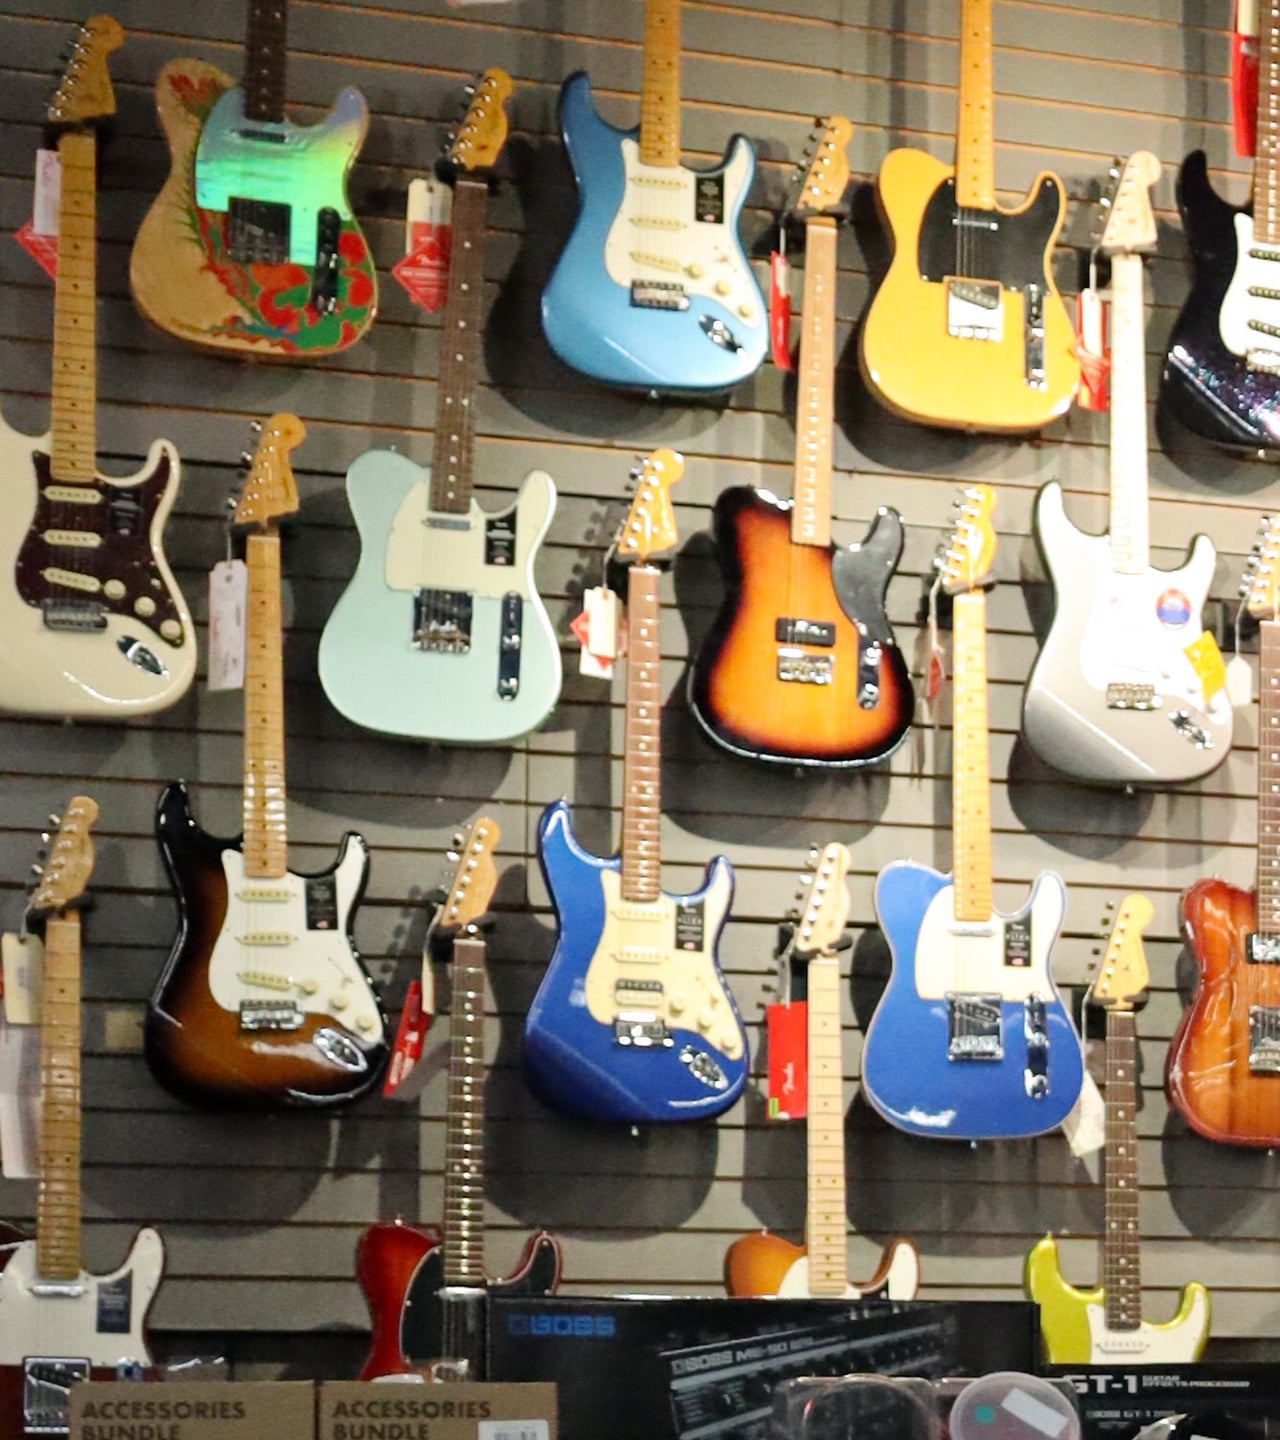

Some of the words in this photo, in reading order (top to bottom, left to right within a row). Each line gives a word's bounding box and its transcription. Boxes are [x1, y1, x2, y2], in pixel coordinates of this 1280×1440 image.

[529, 1313, 616, 1338] BOSS
[82, 1401, 246, 1420] ACCESSORIES
[333, 1400, 492, 1419] ACCESSORIES
